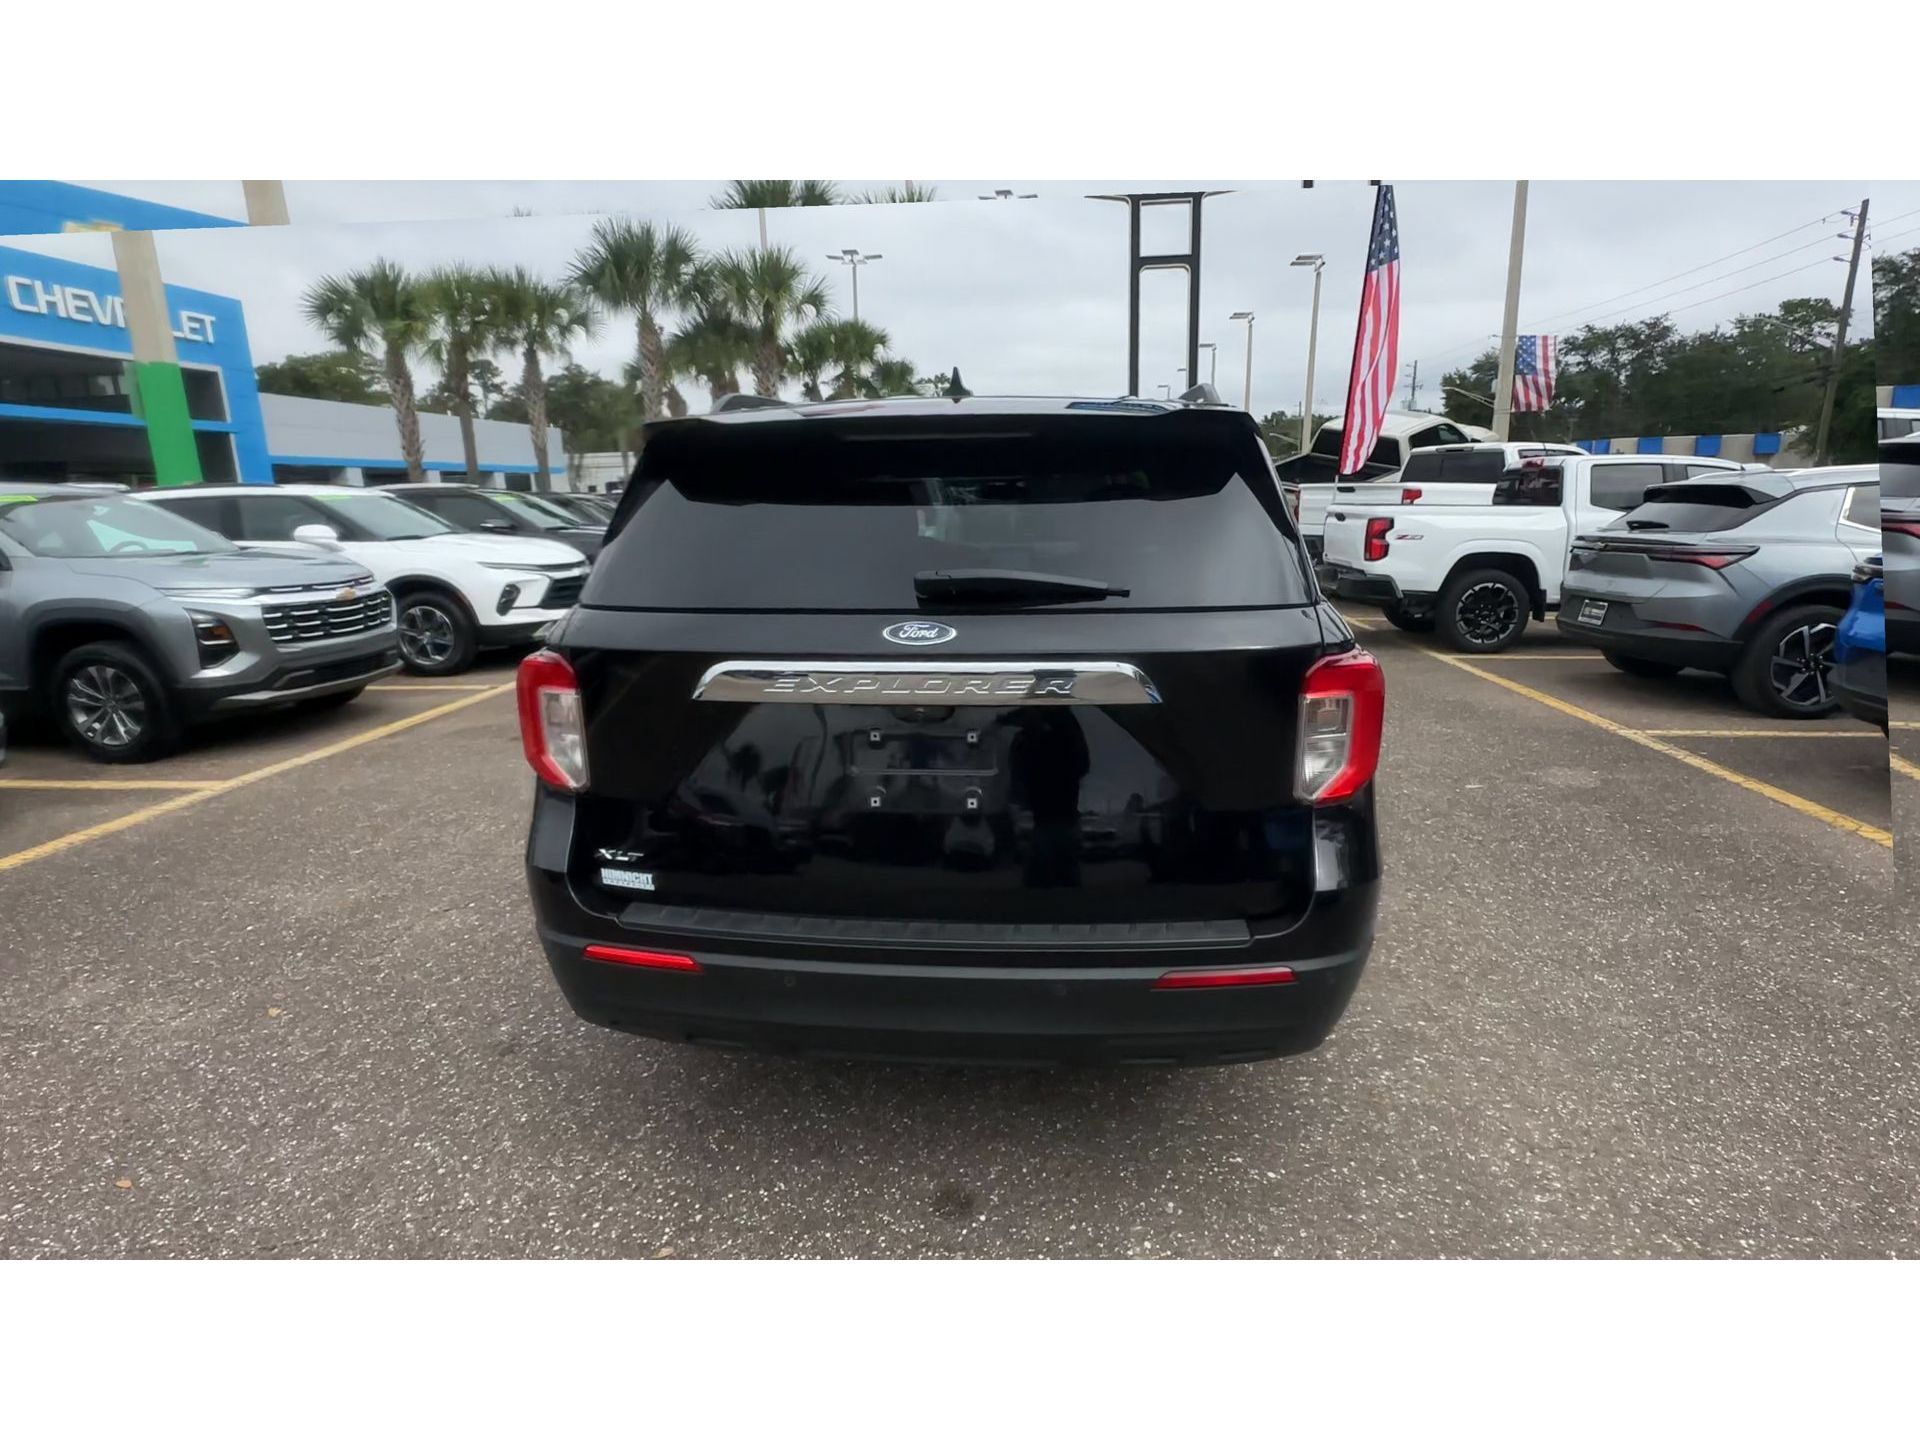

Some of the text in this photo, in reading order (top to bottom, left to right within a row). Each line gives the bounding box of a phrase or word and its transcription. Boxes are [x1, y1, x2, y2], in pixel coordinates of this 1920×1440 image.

[7, 275, 216, 344] CHEVET
[899, 624, 939, 638] Ford
[763, 677, 1074, 695] EXPLORER
[595, 848, 644, 862] XLT
